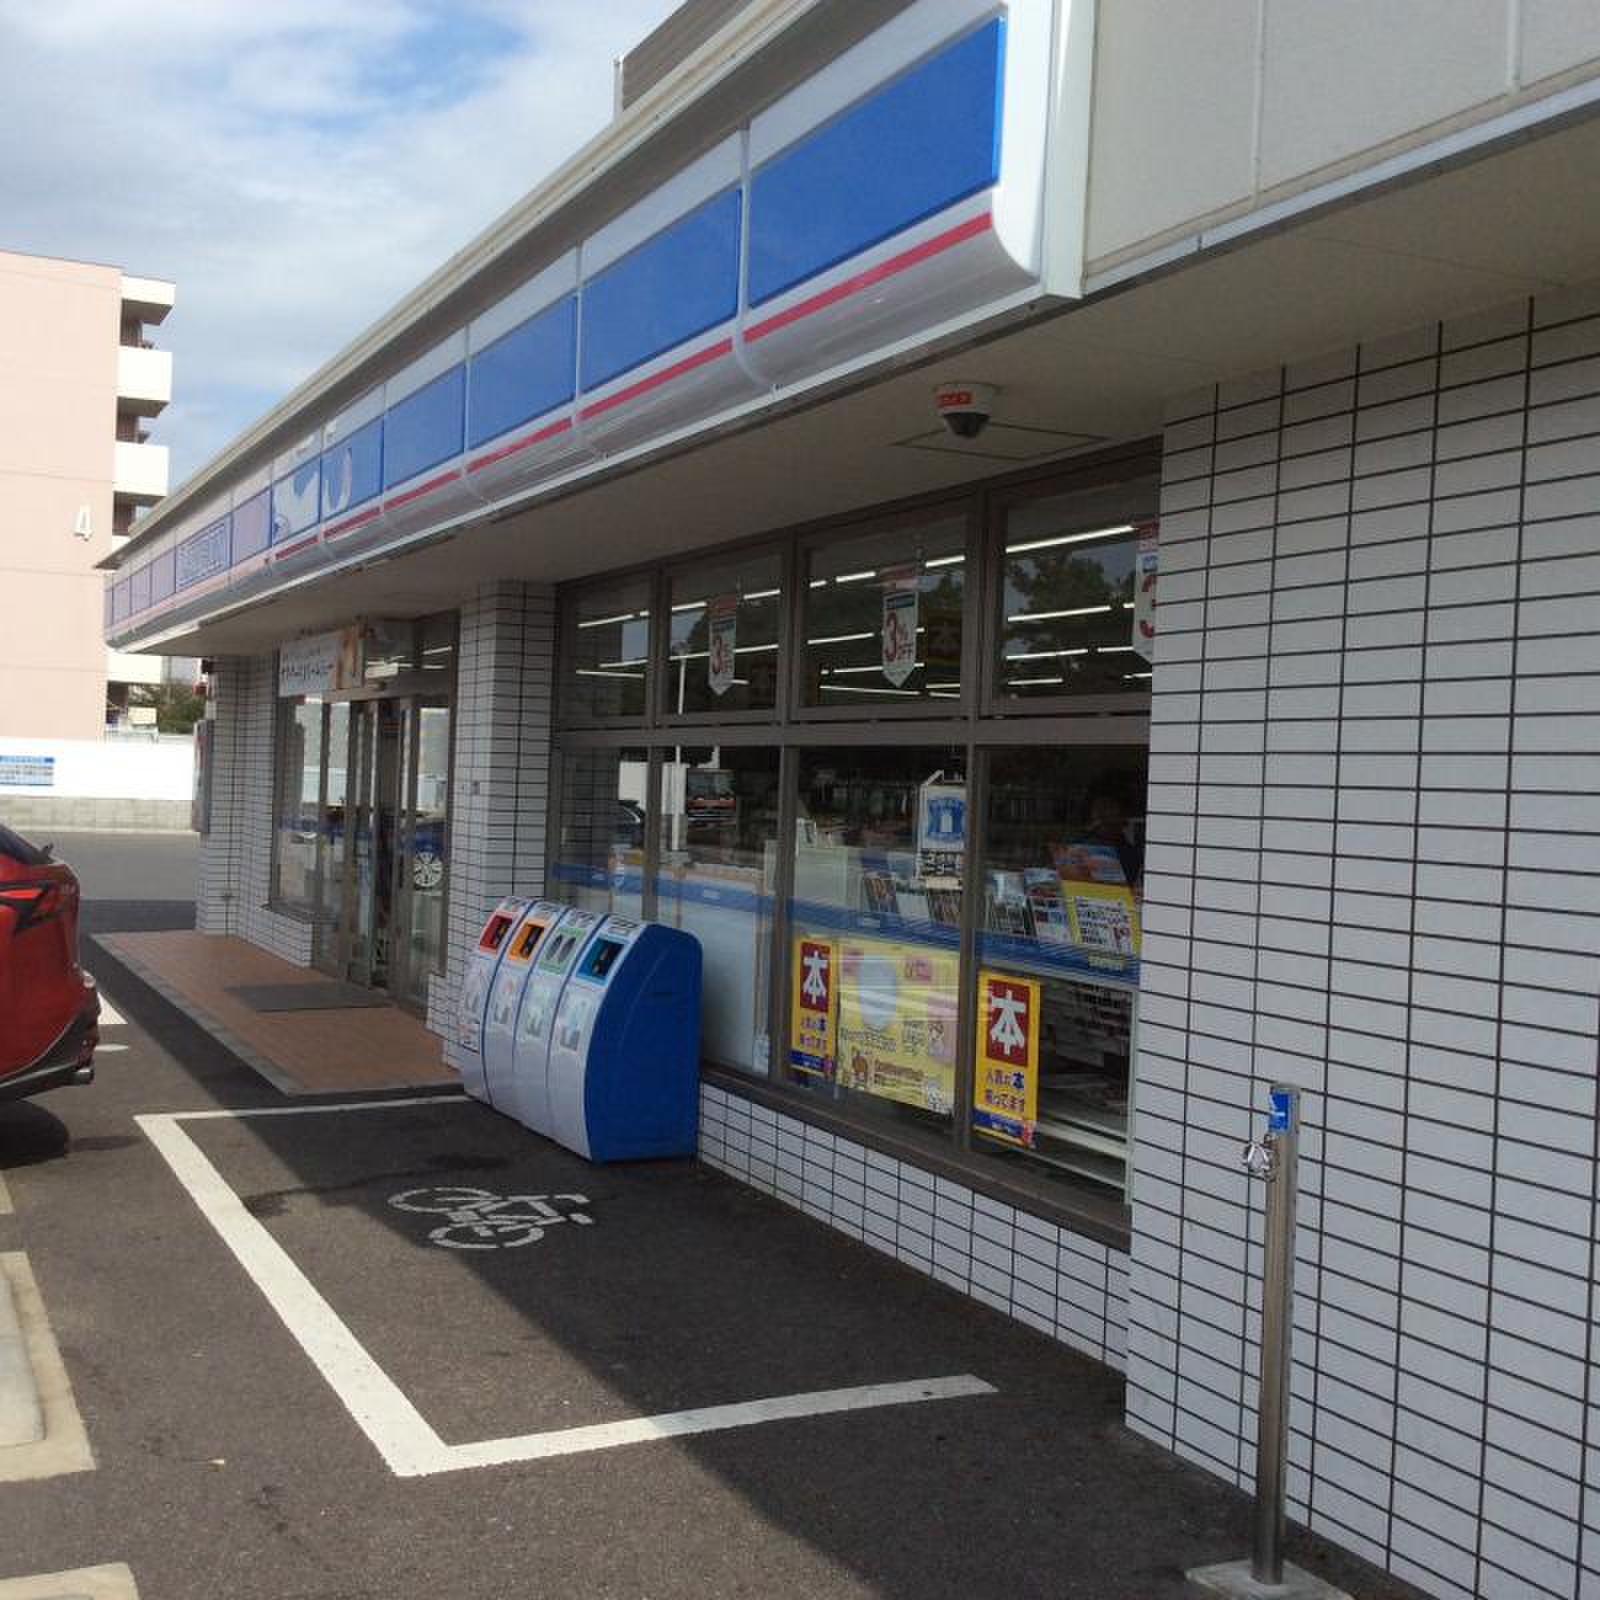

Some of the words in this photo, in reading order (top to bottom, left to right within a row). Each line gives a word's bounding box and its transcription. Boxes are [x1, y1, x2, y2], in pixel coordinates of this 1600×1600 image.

[73, 504, 93, 542] 4
[803, 949, 828, 1005] 本
[989, 990, 1026, 1056] 本
